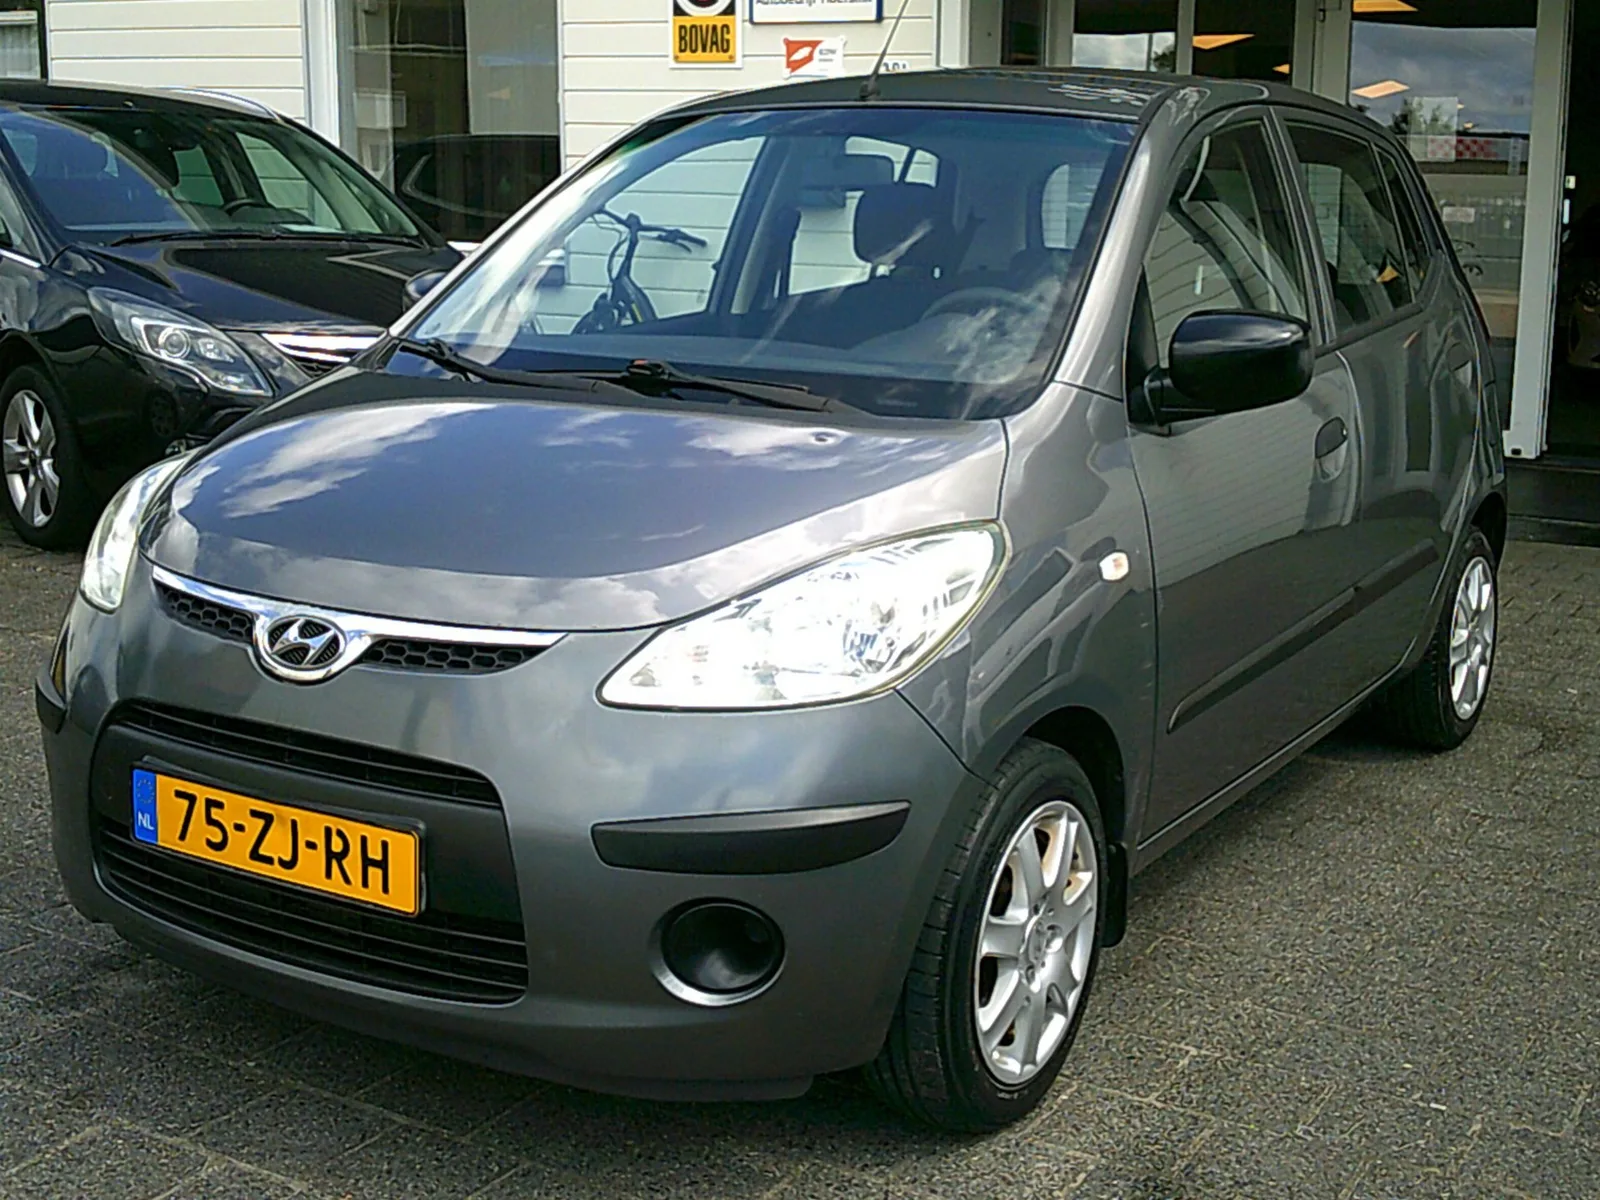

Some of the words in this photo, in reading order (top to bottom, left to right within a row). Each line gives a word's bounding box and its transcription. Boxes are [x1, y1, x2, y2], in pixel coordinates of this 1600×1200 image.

[678, 23, 731, 54] BOVAG
[137, 811, 155, 831] NL
[173, 788, 390, 896] 75-ZJ-RH
